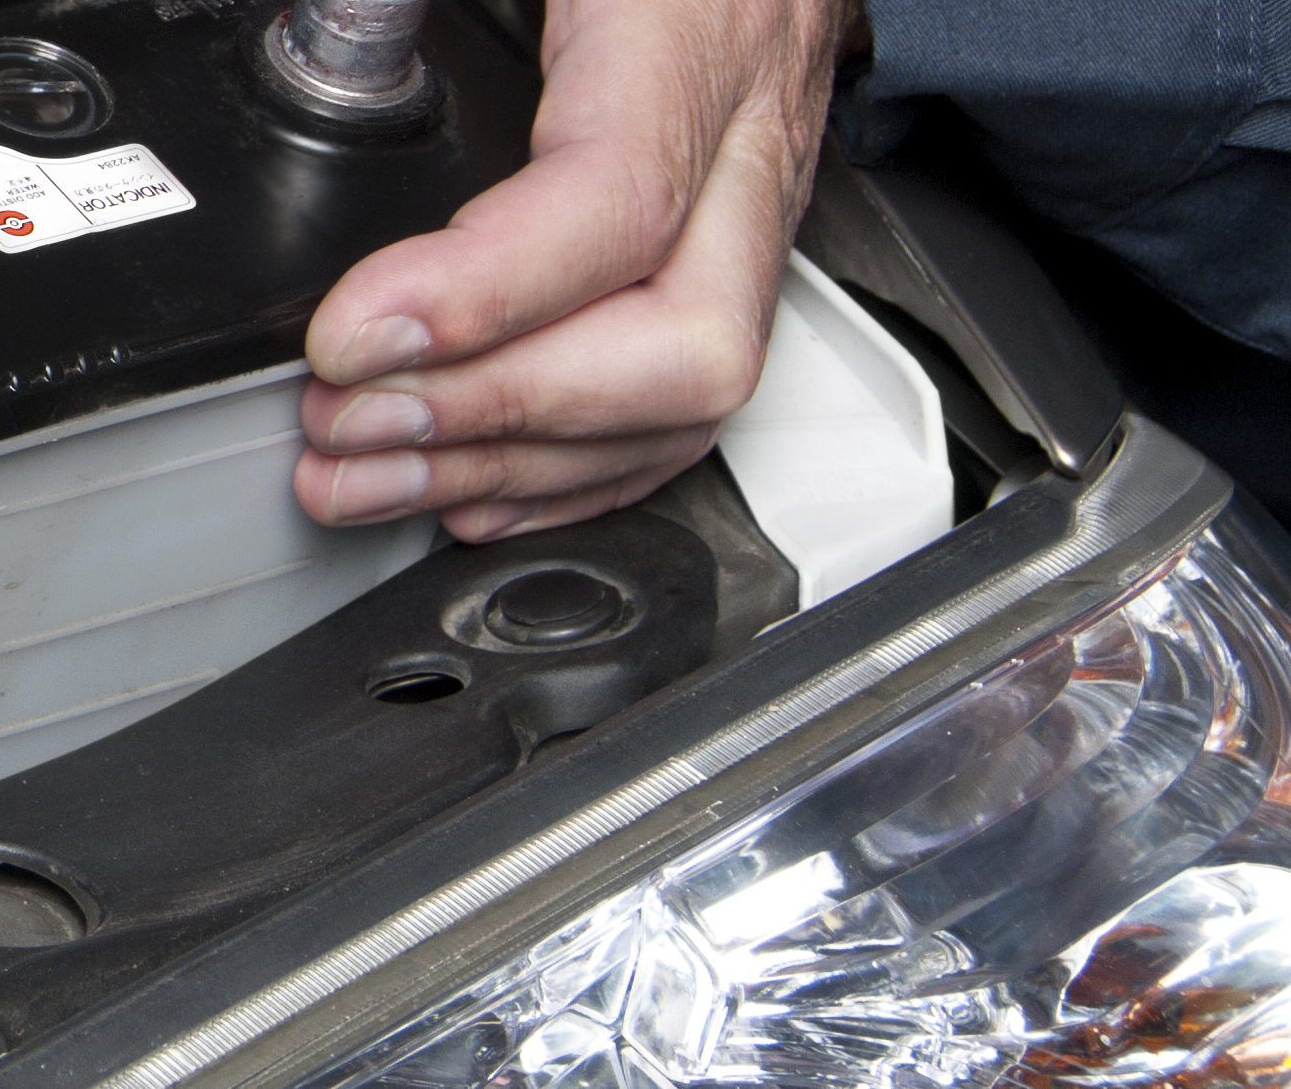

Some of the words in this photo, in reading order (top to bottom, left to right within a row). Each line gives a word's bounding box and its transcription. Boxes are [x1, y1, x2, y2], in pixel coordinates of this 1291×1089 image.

[5, 183, 40, 196] WATER
[24, 189, 46, 202] ADD
[81, 182, 172, 212] INDICATOR
